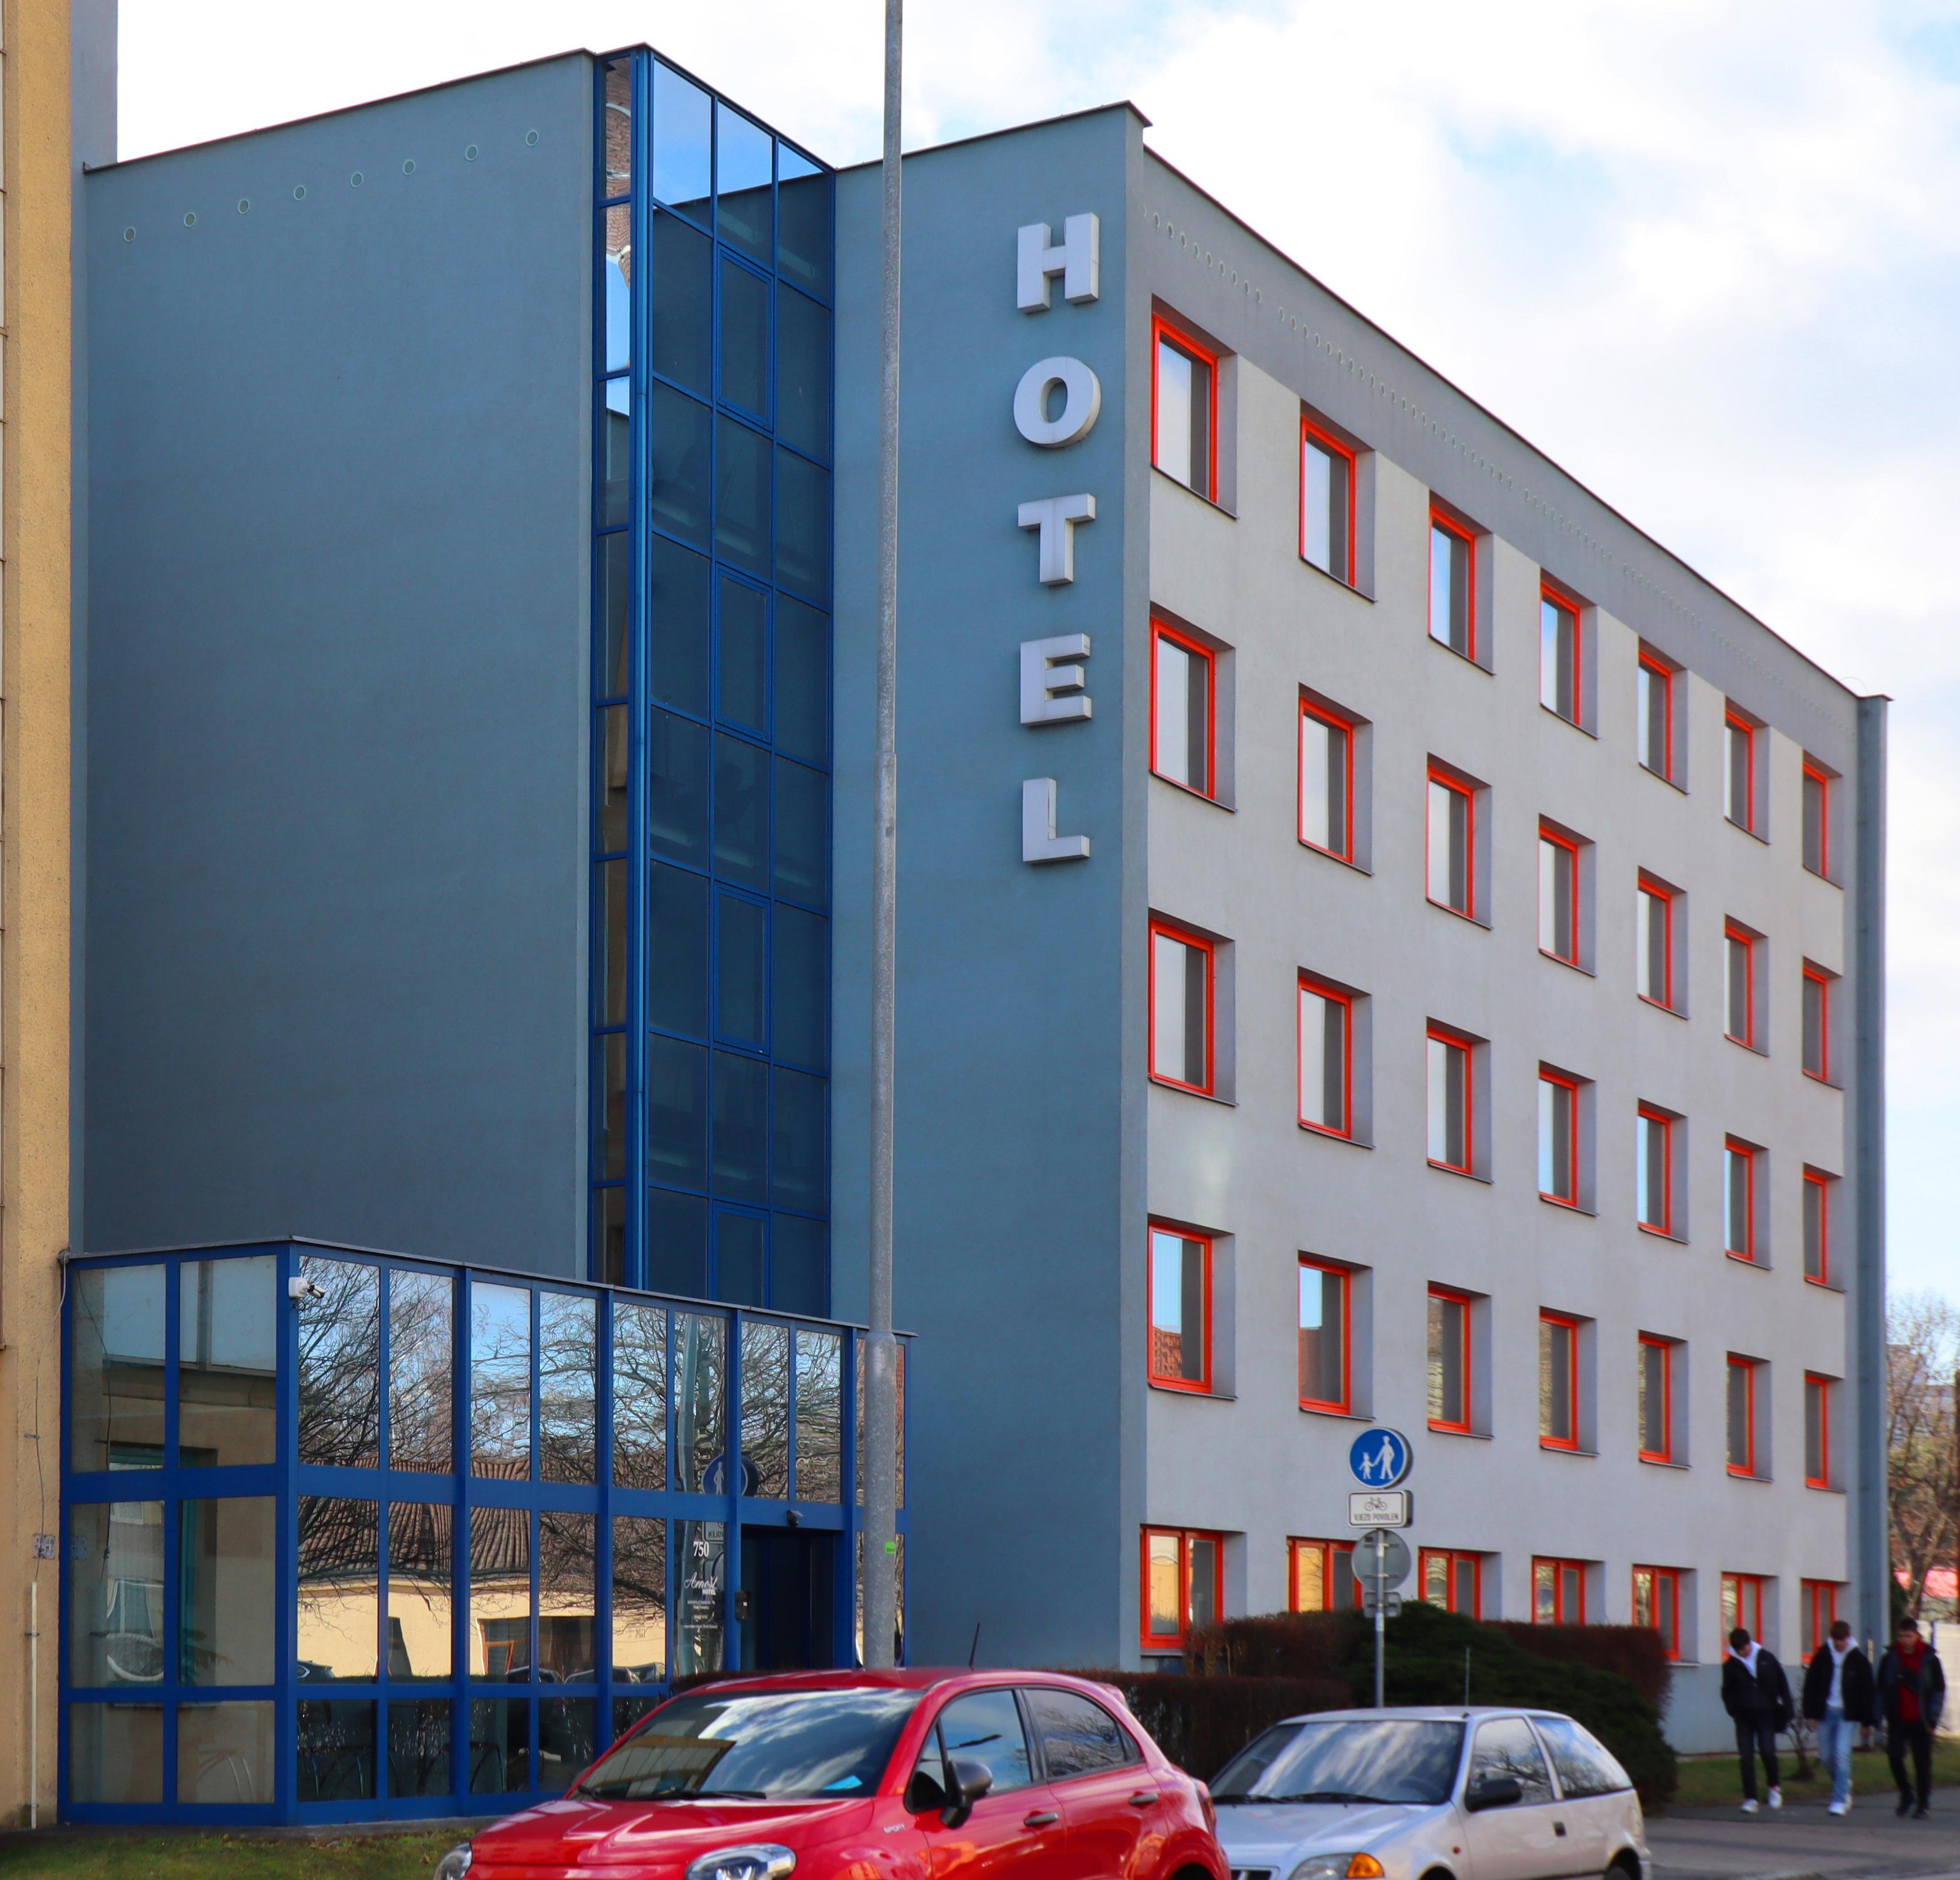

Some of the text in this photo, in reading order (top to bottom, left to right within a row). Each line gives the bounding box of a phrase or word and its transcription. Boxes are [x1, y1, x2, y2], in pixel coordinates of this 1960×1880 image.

[1014, 212, 1101, 864] HOTEL
[1373, 1513, 1399, 1521] POVOLEN
[693, 1541, 709, 1557] 750
[883, 1823, 906, 1834] SPORT
